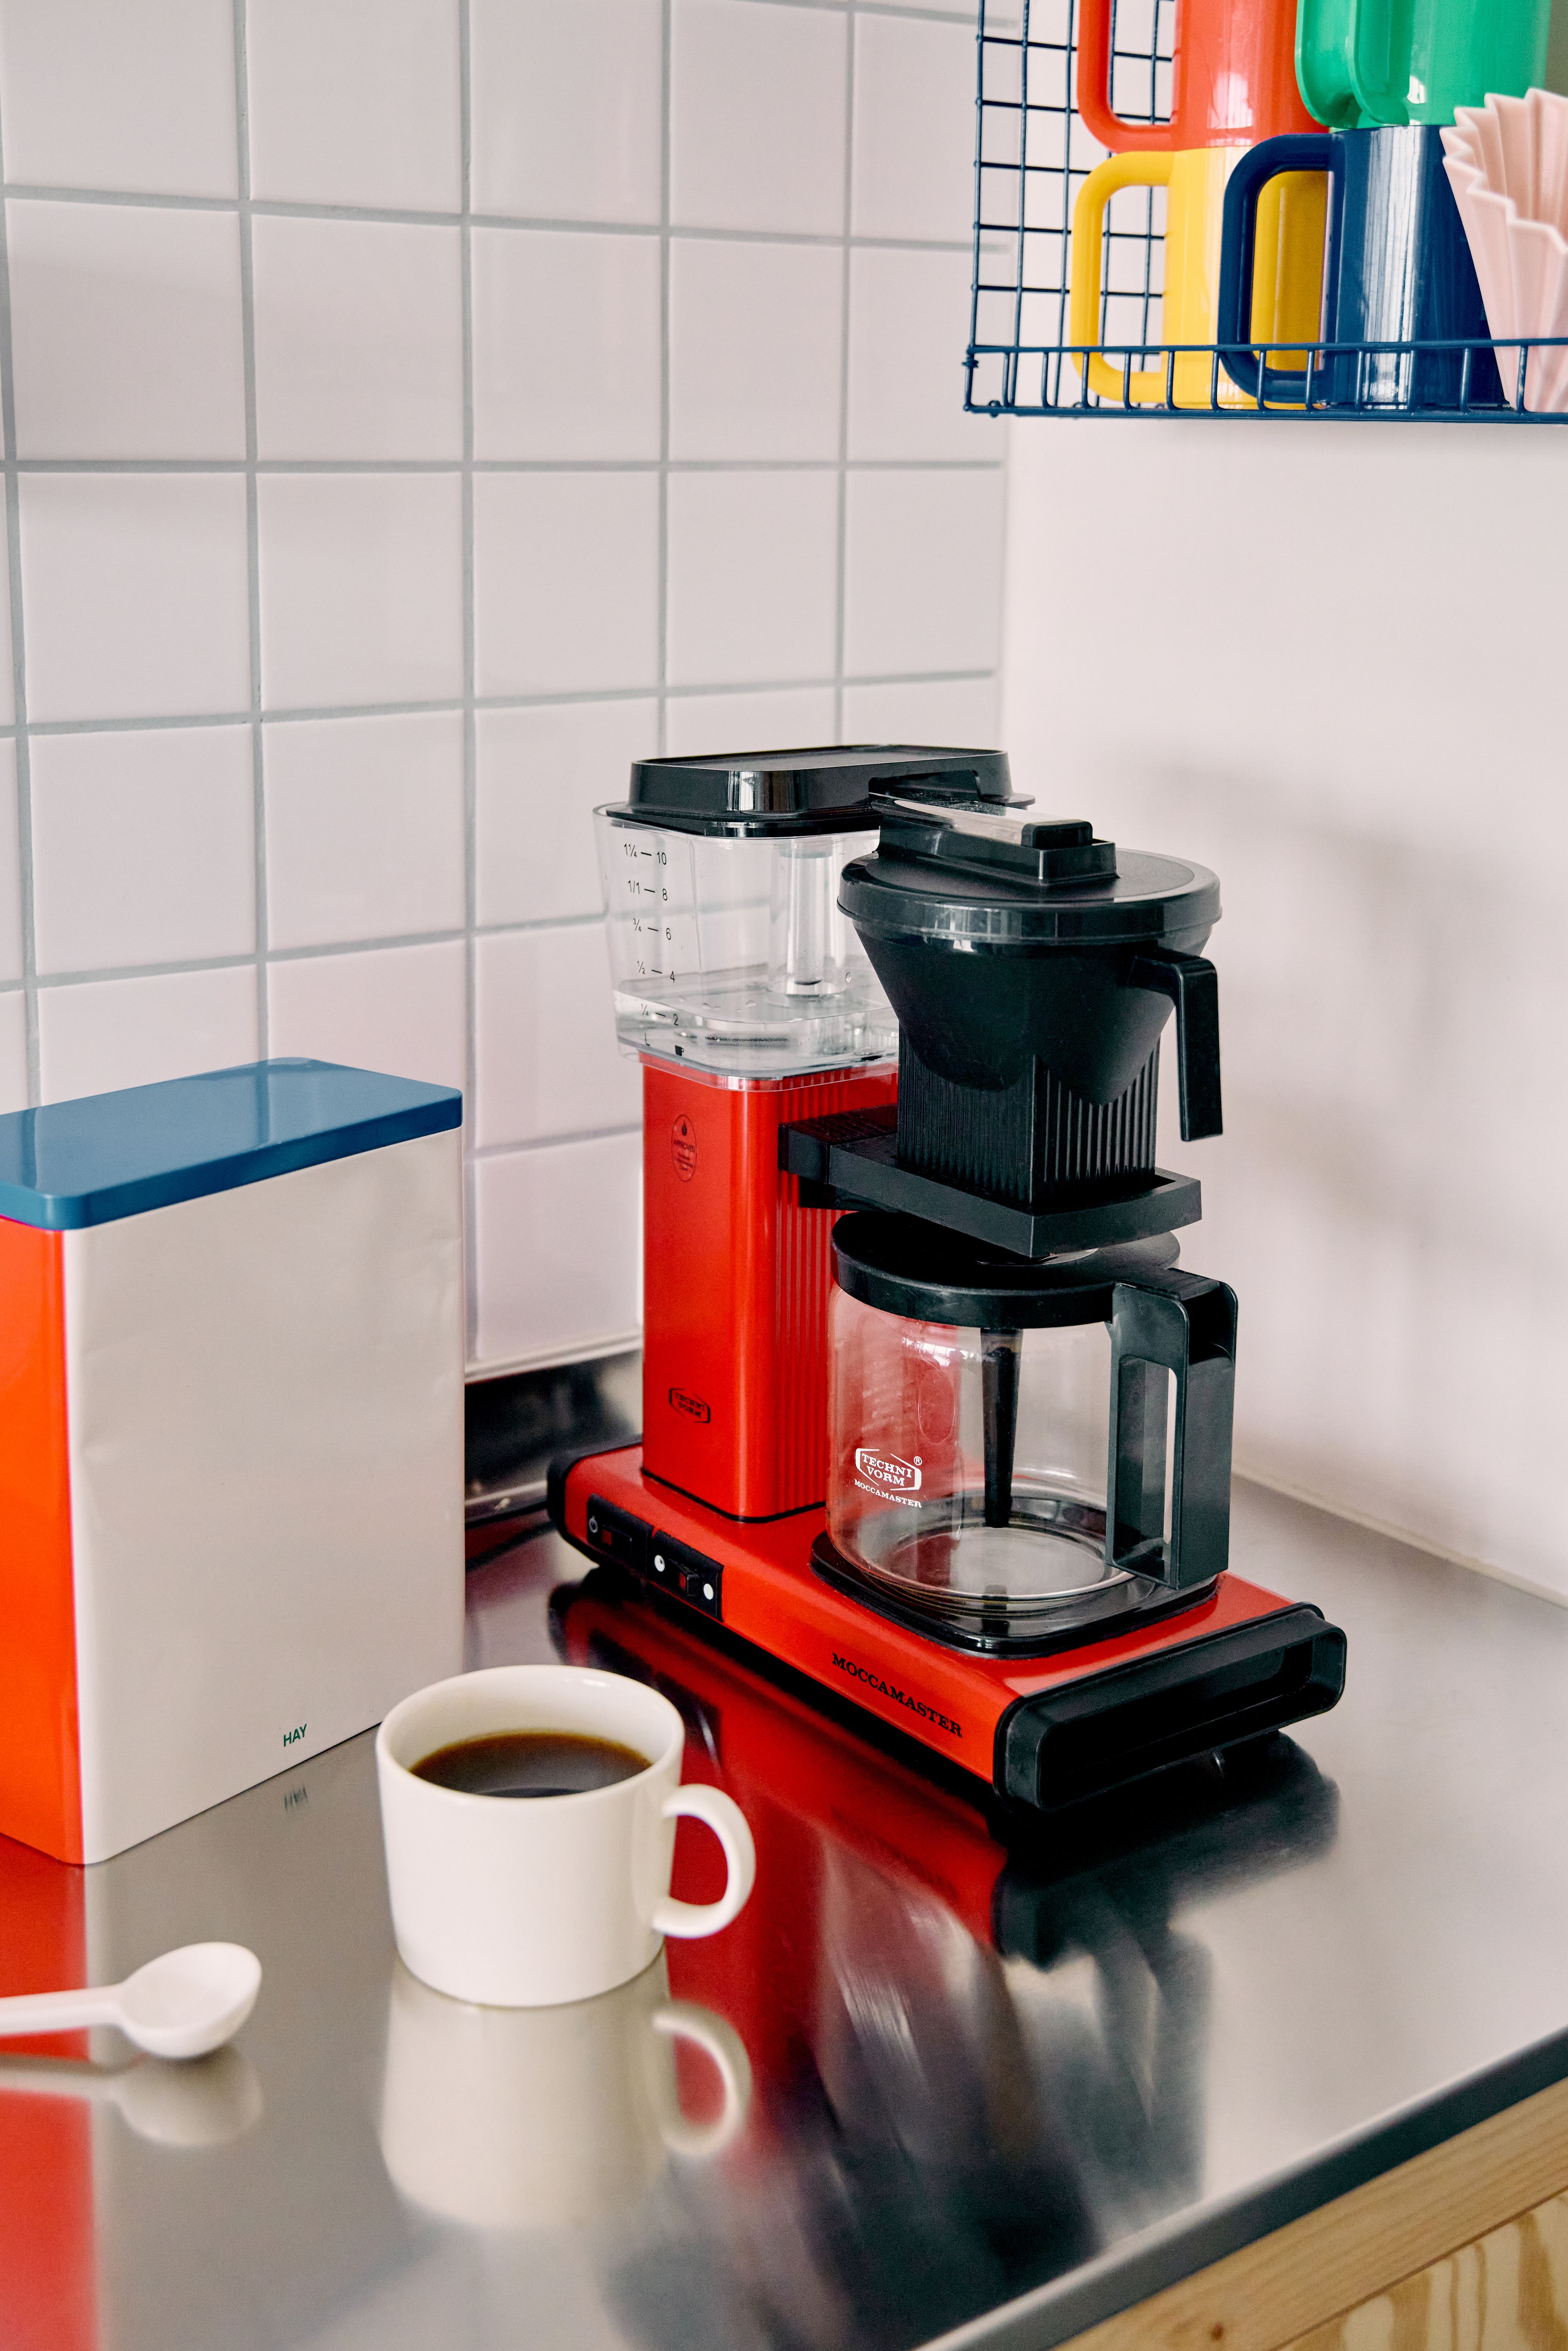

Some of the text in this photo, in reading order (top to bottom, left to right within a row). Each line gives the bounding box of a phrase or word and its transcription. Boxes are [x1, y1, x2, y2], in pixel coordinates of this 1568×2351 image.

[657, 851, 667, 865] 10
[628, 880, 668, 901] 1/1 8
[666, 927, 671, 940] 6
[670, 971, 675, 983] 4
[673, 1014, 679, 1026] 2
[644, 1033, 650, 1046] L
[862, 1453, 912, 1478] TECHNI
[866, 1466, 905, 1486] VORM
[854, 1479, 922, 1508] MOCCAMASTER
[832, 1653, 962, 1738] MOCCAMASTER
[283, 1723, 307, 1747] HAY
